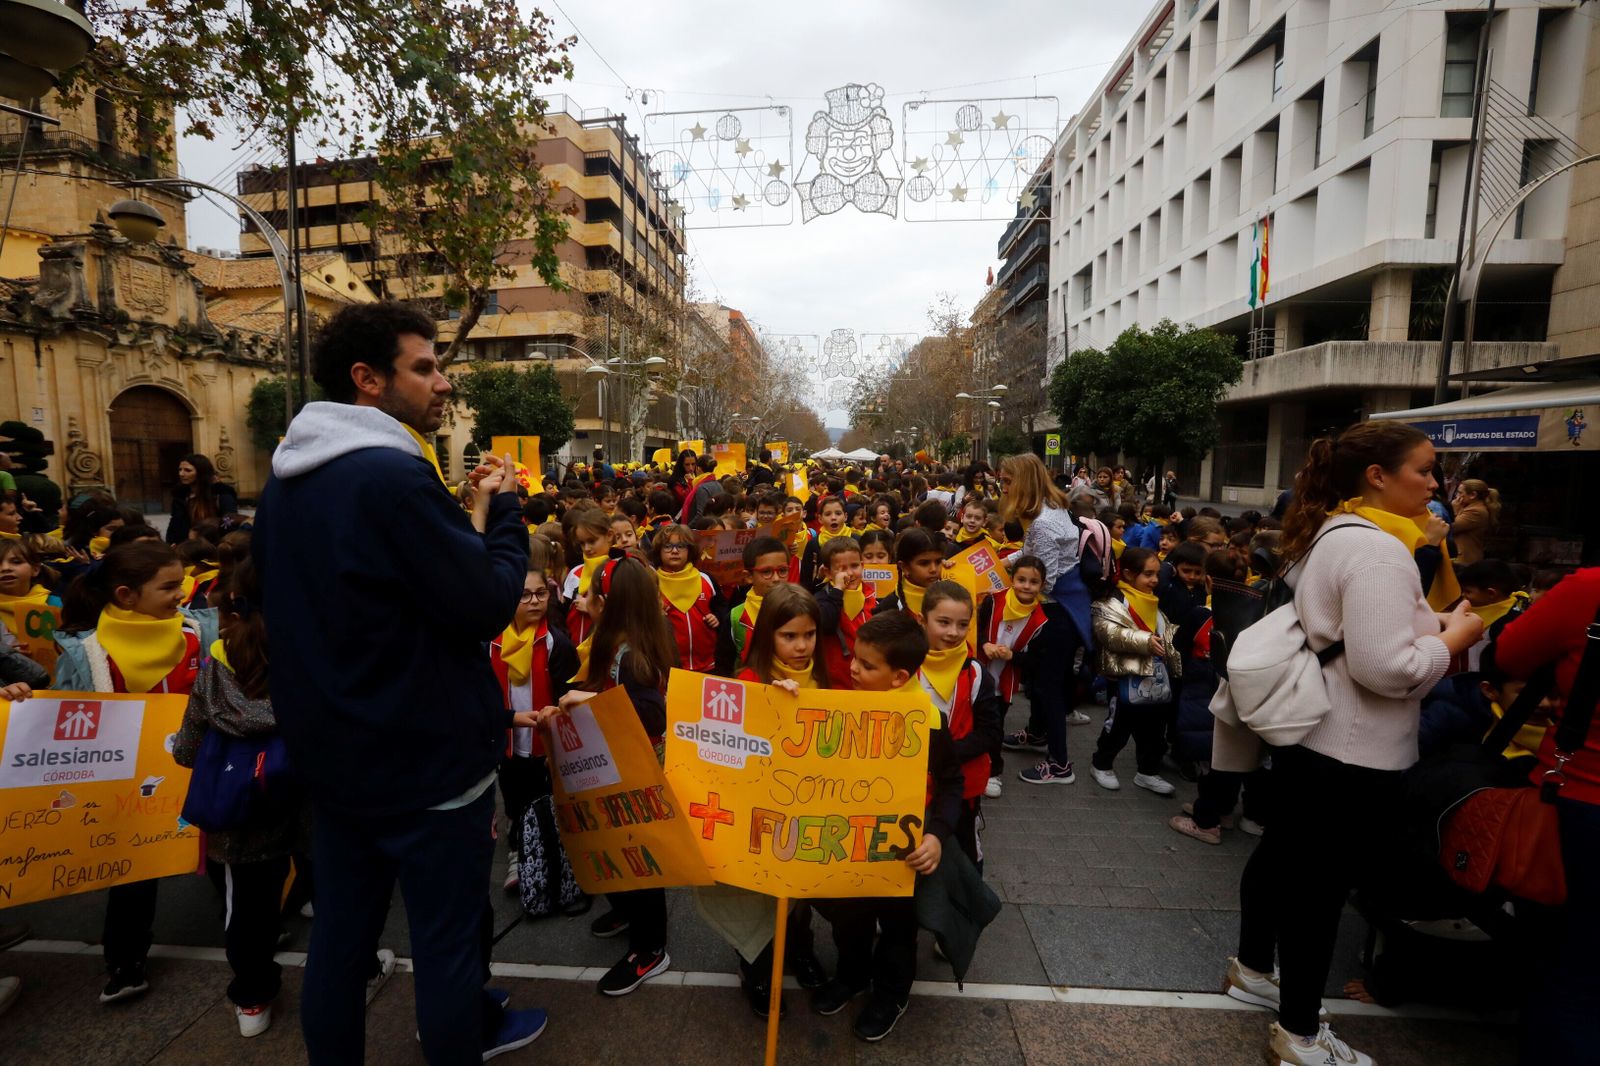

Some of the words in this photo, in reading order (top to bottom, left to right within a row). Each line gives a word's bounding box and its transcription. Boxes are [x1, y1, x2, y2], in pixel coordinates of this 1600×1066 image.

[1455, 432, 1490, 440] APUESTAS
[1506, 431, 1536, 439] ESTADO
[987, 571, 1004, 590] sale
[675, 722, 772, 757] salesianos
[781, 707, 926, 760] JUNTOS
[11, 746, 125, 768] salesianos
[559, 753, 609, 777] salesianos
[698, 747, 744, 767] CÓRDOBA
[43, 769, 96, 783] CÓRDOBA
[769, 769, 894, 806] Somos
[88, 831, 117, 849] LOS
[748, 807, 923, 865] FUERTES
[52, 858, 133, 891] REALIDAD
